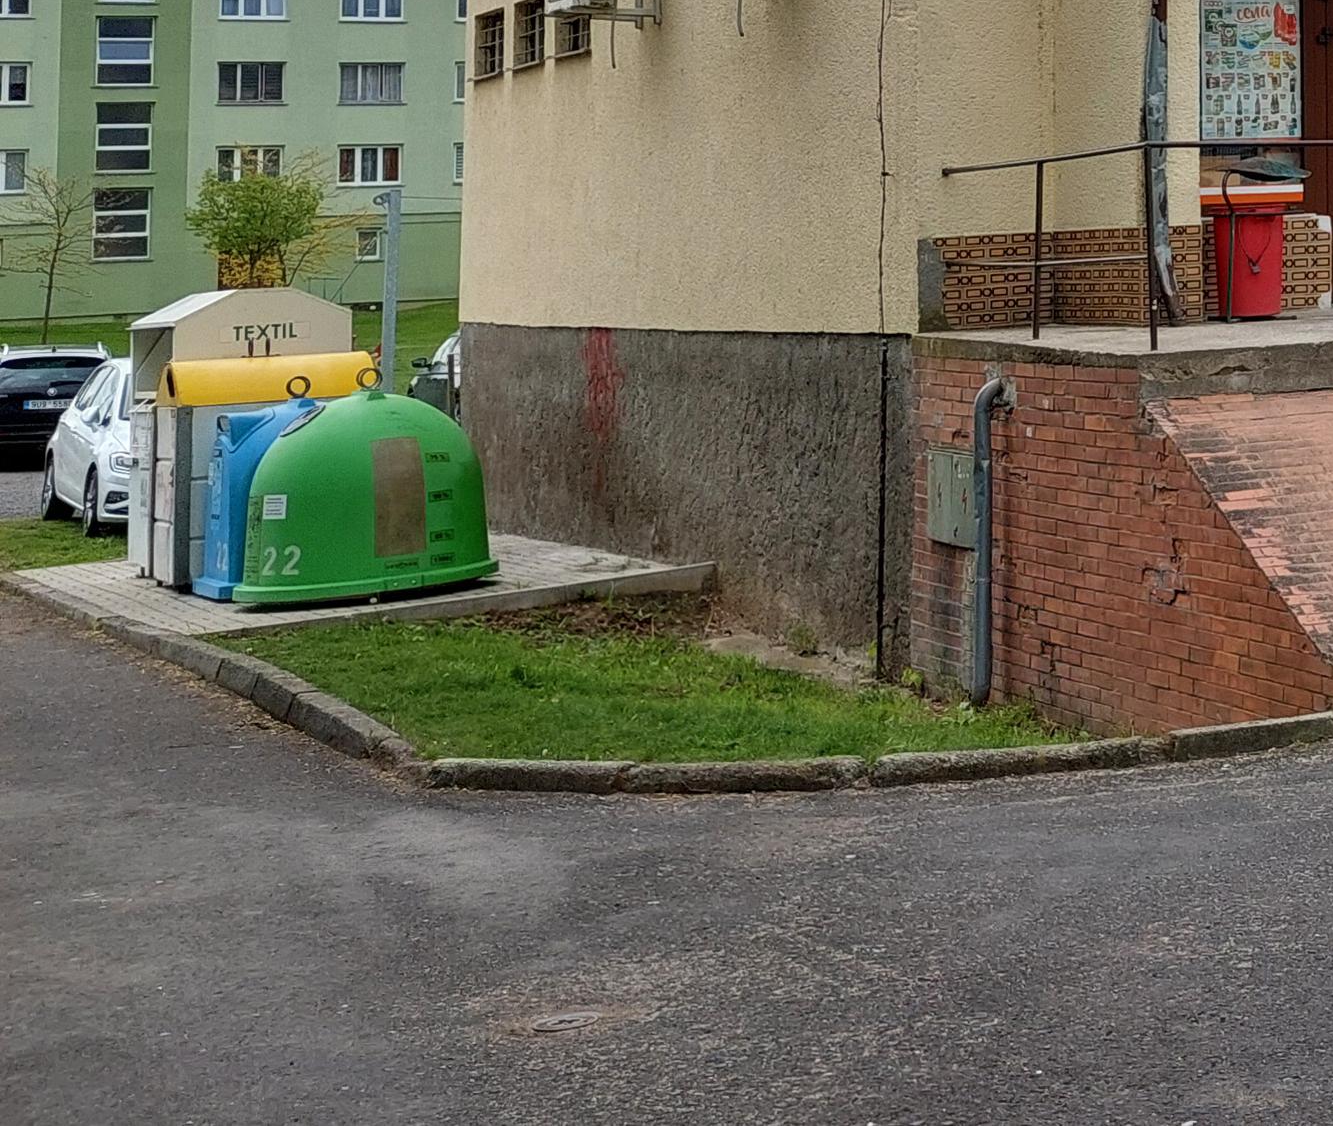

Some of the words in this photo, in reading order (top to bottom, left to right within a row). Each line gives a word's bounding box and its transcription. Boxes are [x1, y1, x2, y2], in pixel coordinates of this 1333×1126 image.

[1236, 5, 1271, 21] cena
[233, 322, 298, 341] TEXTIL
[262, 544, 301, 576] 22
